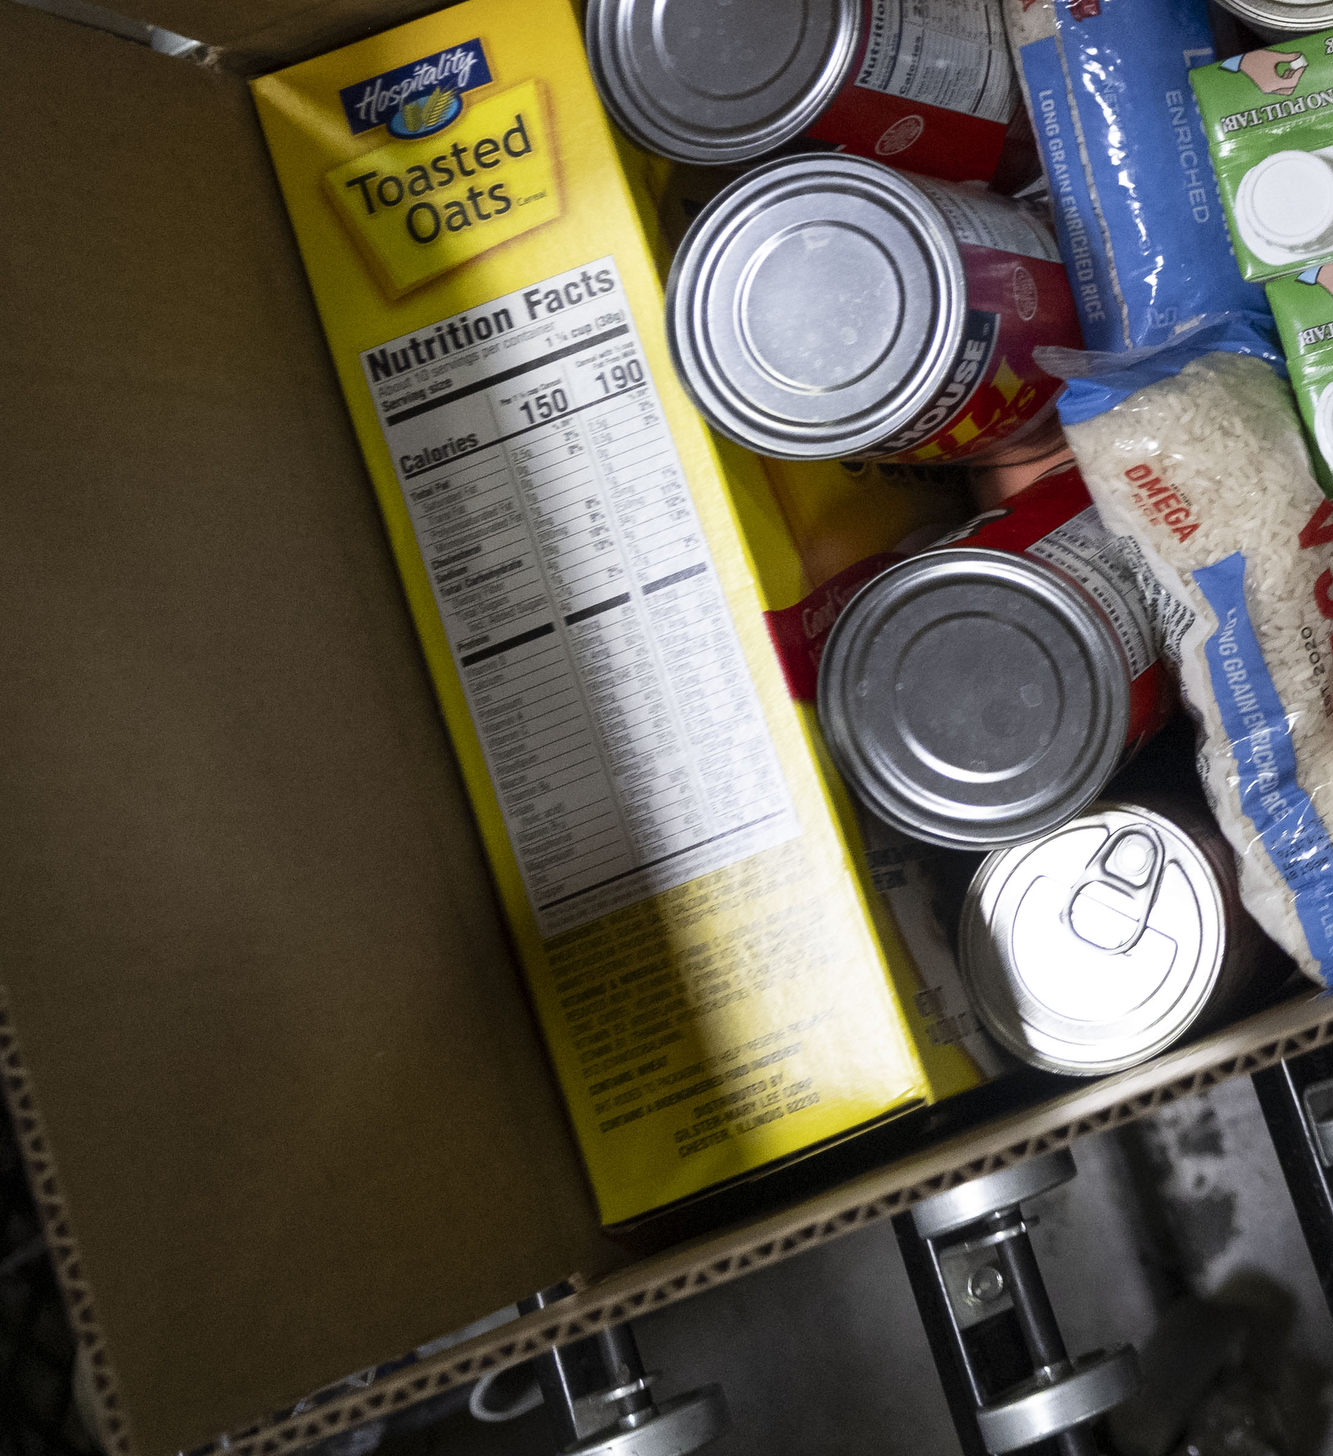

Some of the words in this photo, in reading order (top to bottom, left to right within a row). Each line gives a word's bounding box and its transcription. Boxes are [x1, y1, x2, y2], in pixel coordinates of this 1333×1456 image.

[349, 43, 484, 127] Hospitality
[1035, 88, 1063, 137] LONG
[1260, 95, 1305, 122] PULL
[1218, 106, 1263, 133] TAB!
[344, 113, 534, 219] Toasted
[1045, 137, 1076, 194] GRAIN
[1162, 89, 1212, 224] ENRICHED
[401, 171, 513, 247] Oats
[1058, 195, 1096, 282] ENRICHED
[365, 300, 515, 384] Nutrition
[522, 261, 616, 322] Facts
[570, 321, 592, 338] cup
[1080, 283, 1106, 323] RICE
[381, 385, 426, 414] Serving
[427, 375, 453, 395] size
[518, 386, 570, 427] 150
[593, 357, 645, 397] 190
[889, 335, 991, 455] HOUSE
[399, 428, 479, 475] Calories
[1123, 454, 1200, 545] OMEGA
[1299, 625, 1326, 676] 2020
[1220, 655, 1260, 716] GRAIN
[1238, 709, 1282, 796] ENRICHED
